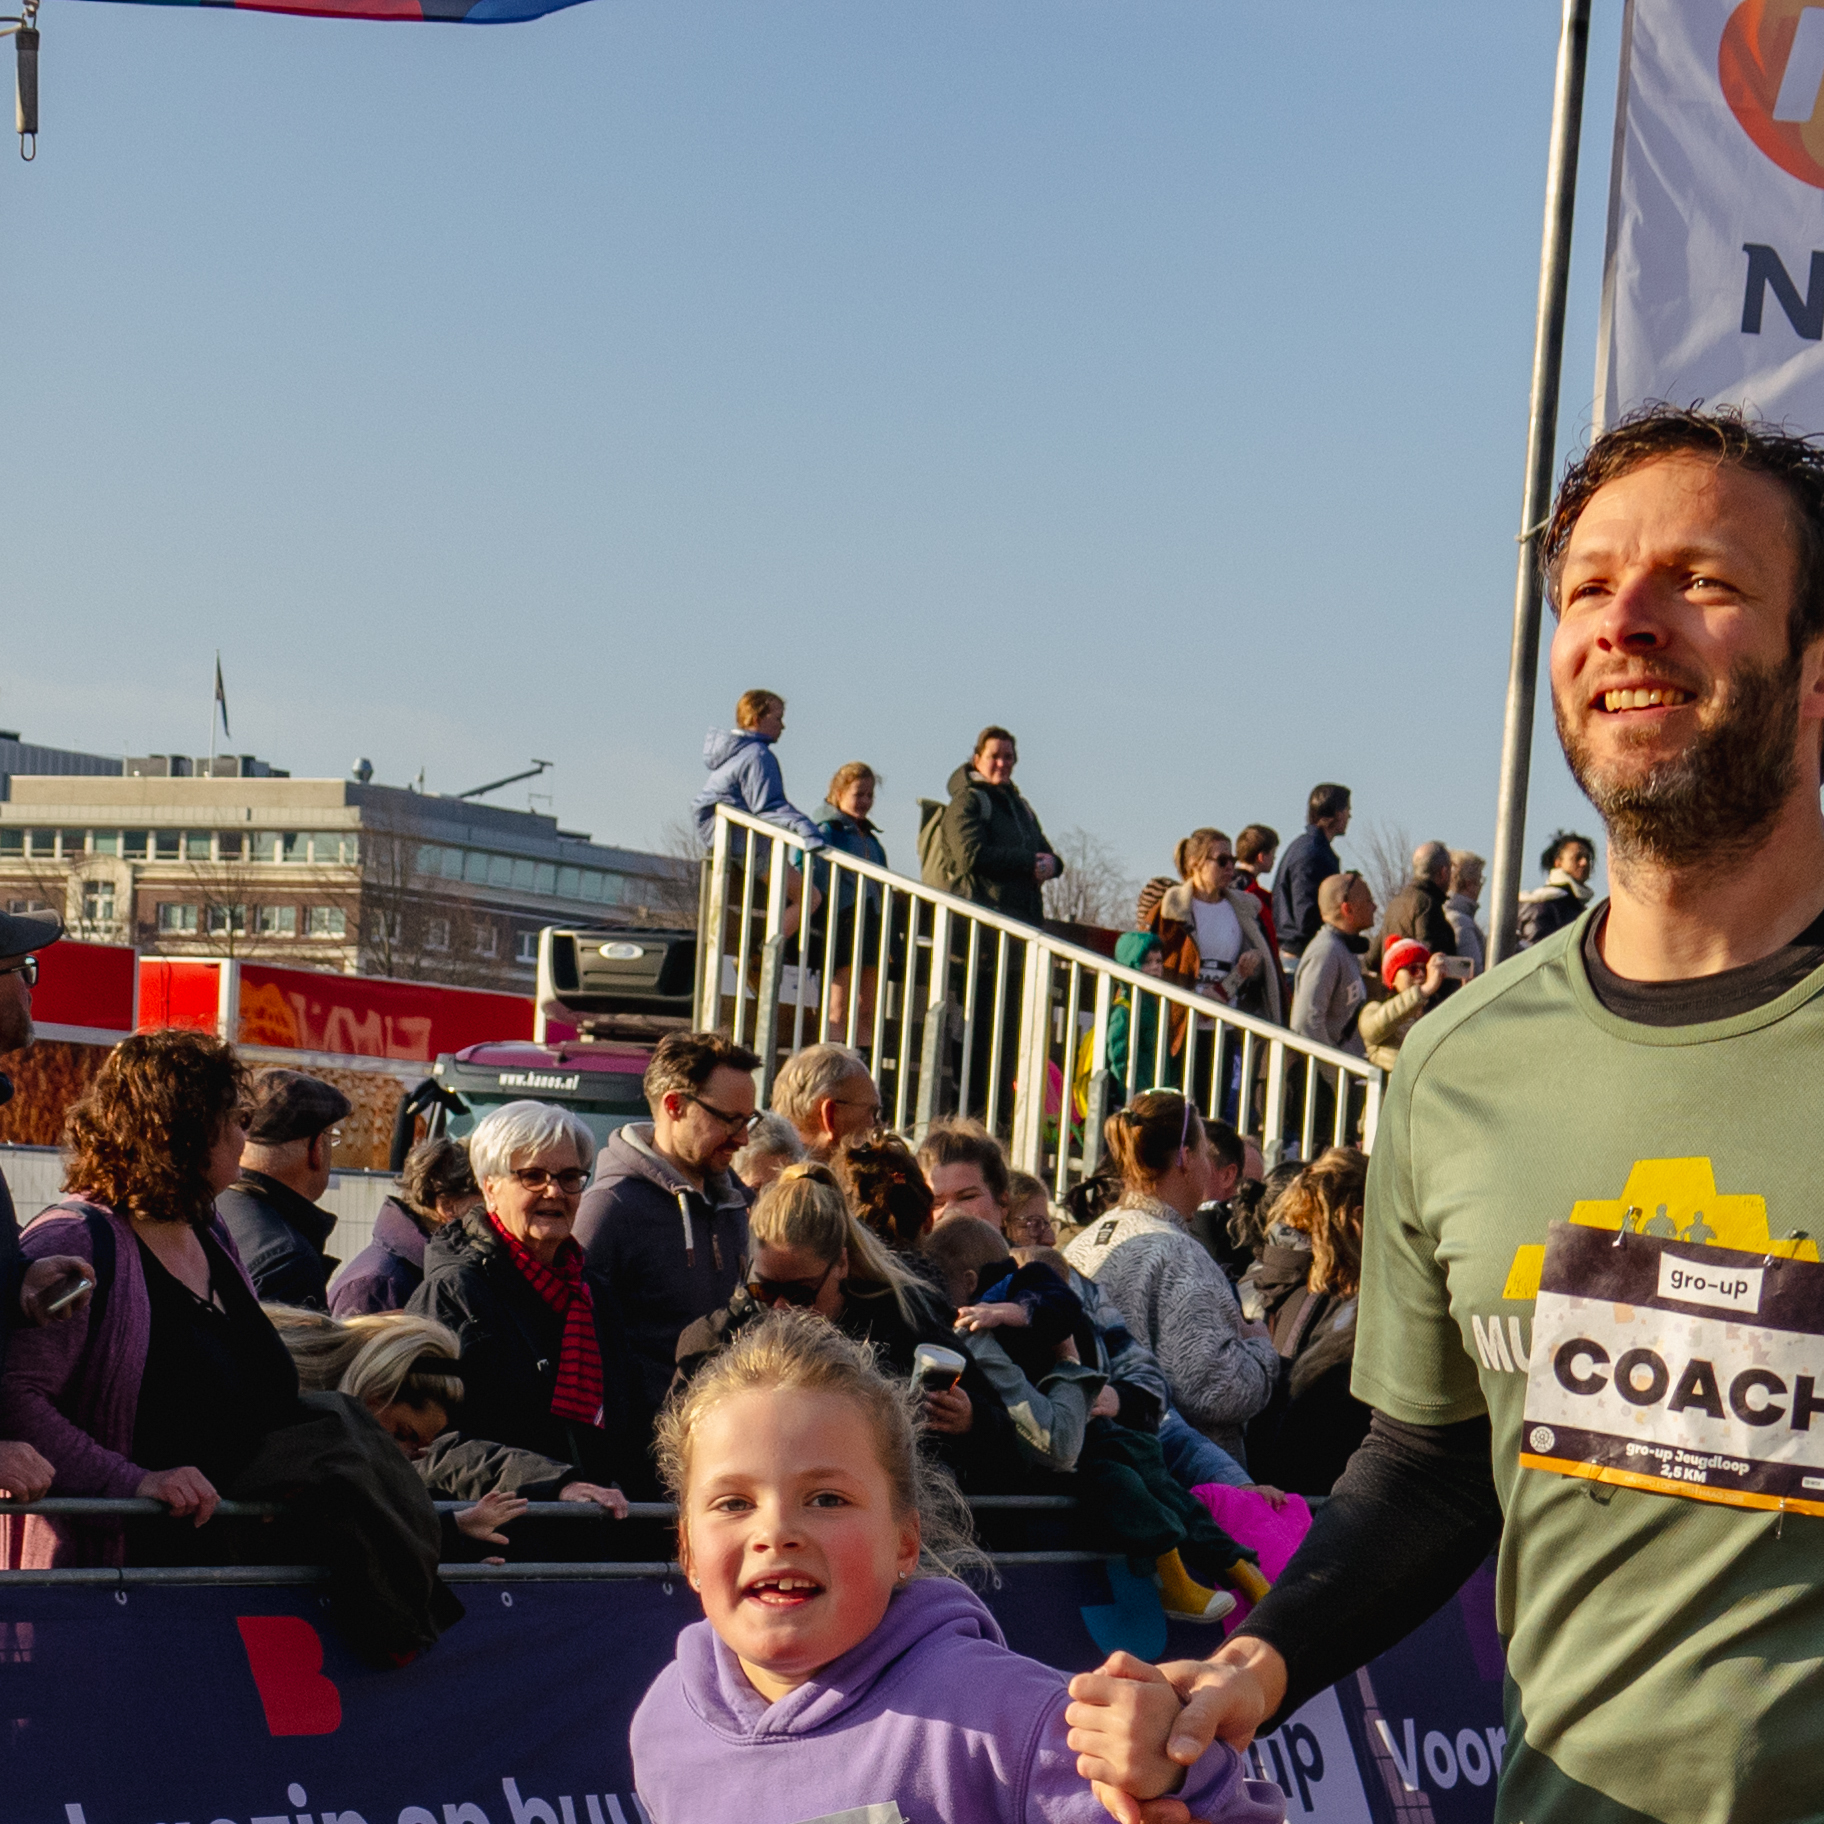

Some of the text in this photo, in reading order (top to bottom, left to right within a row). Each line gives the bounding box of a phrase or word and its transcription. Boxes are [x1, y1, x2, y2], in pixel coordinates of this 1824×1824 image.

[1669, 1267, 1749, 1299] gro-up
[1471, 1314, 1536, 1374] MU
[1625, 1442, 1751, 1475] gro-up Jeugdloop
[1683, 1469, 1707, 1483] KM
